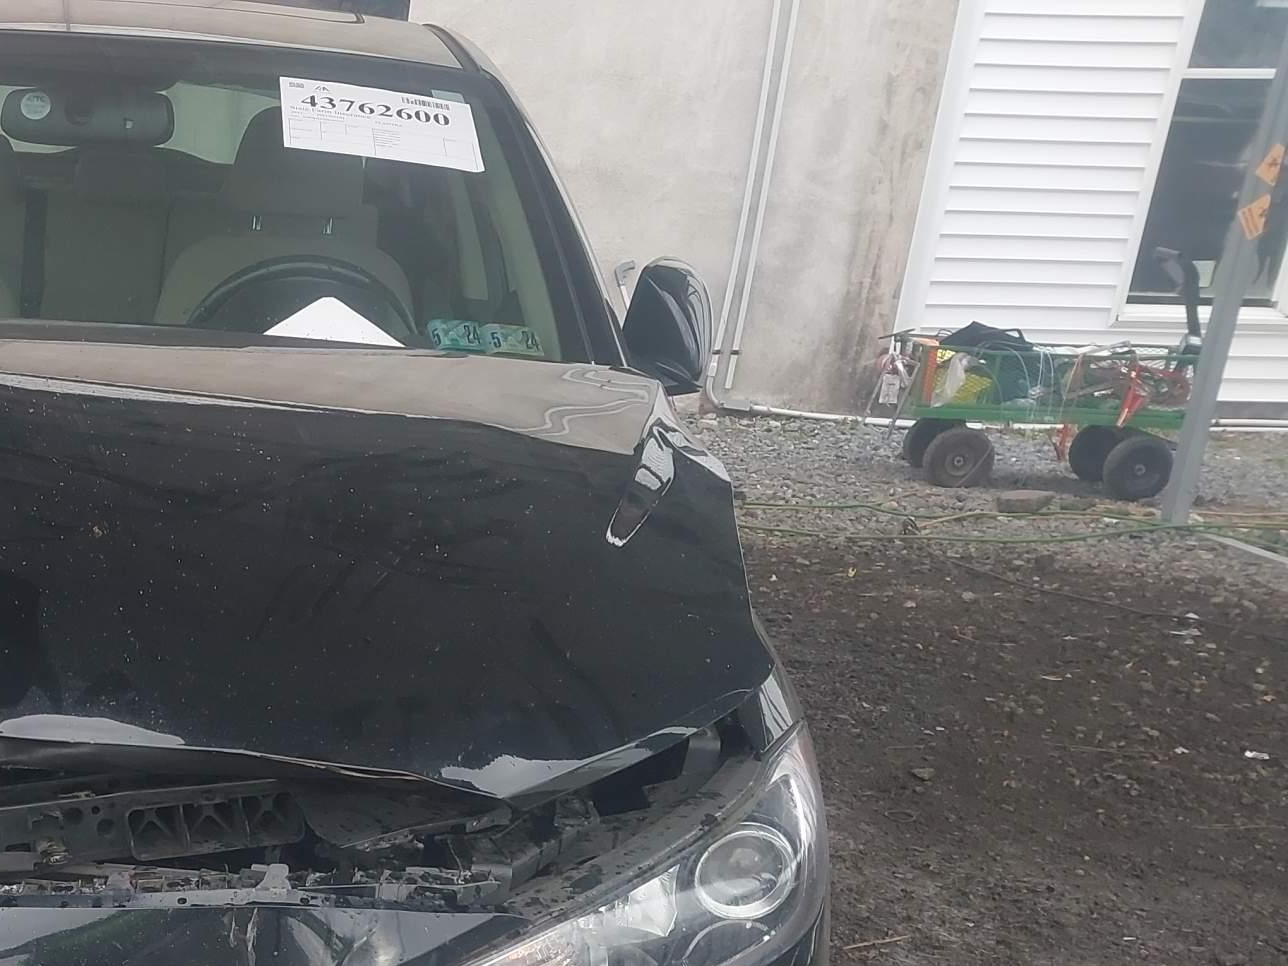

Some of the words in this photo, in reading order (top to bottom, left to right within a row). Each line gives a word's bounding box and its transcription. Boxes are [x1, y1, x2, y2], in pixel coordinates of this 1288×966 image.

[300, 94, 451, 127] 43762600
[431, 328, 442, 346] 5
[463, 324, 481, 345] 24
[491, 331, 501, 348] 5
